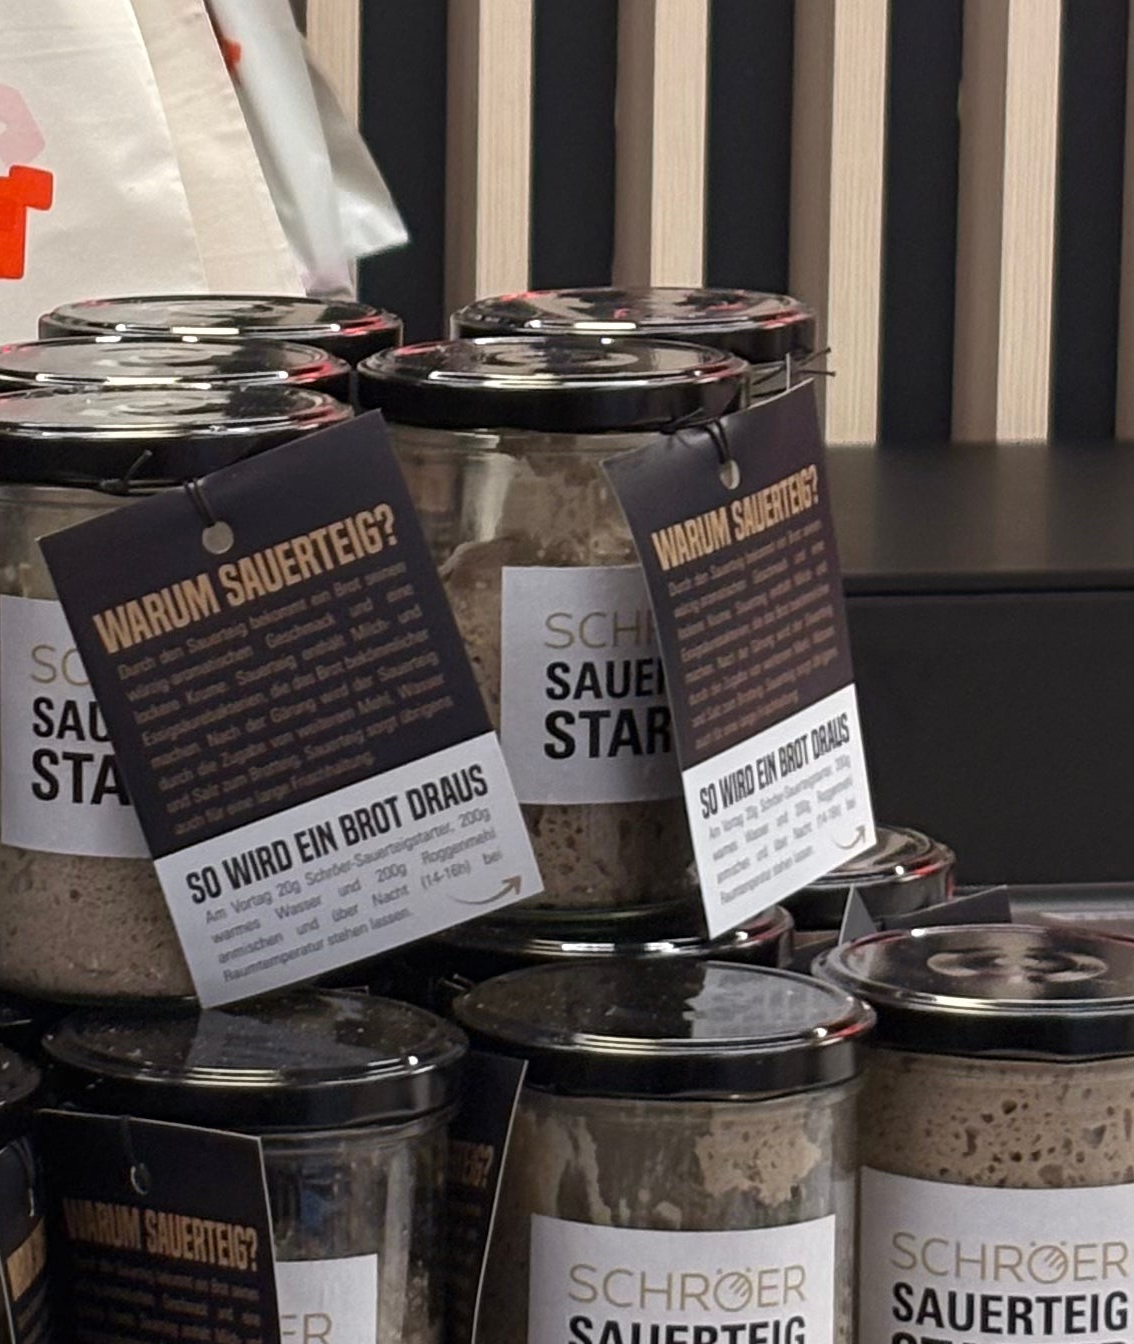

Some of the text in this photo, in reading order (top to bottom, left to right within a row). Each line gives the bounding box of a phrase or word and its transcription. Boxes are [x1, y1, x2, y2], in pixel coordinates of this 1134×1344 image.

[654, 467, 818, 571] WARUM SAUERTEIG?
[93, 503, 402, 654] WARUM SAUERTEIG?
[545, 658, 665, 700] SAUE
[543, 706, 673, 760] STAR
[700, 714, 847, 817] SO WIRD EIN BROT DRAUS
[184, 765, 489, 903] SO WIRD EIN BROT DRAUS
[143, 1209, 259, 1272] SAUERTEIG?
[890, 1231, 1130, 1284] SCHRÖER
[567, 1263, 807, 1313] SCHRÖER
[892, 1281, 1129, 1336] SAUERTEIG
